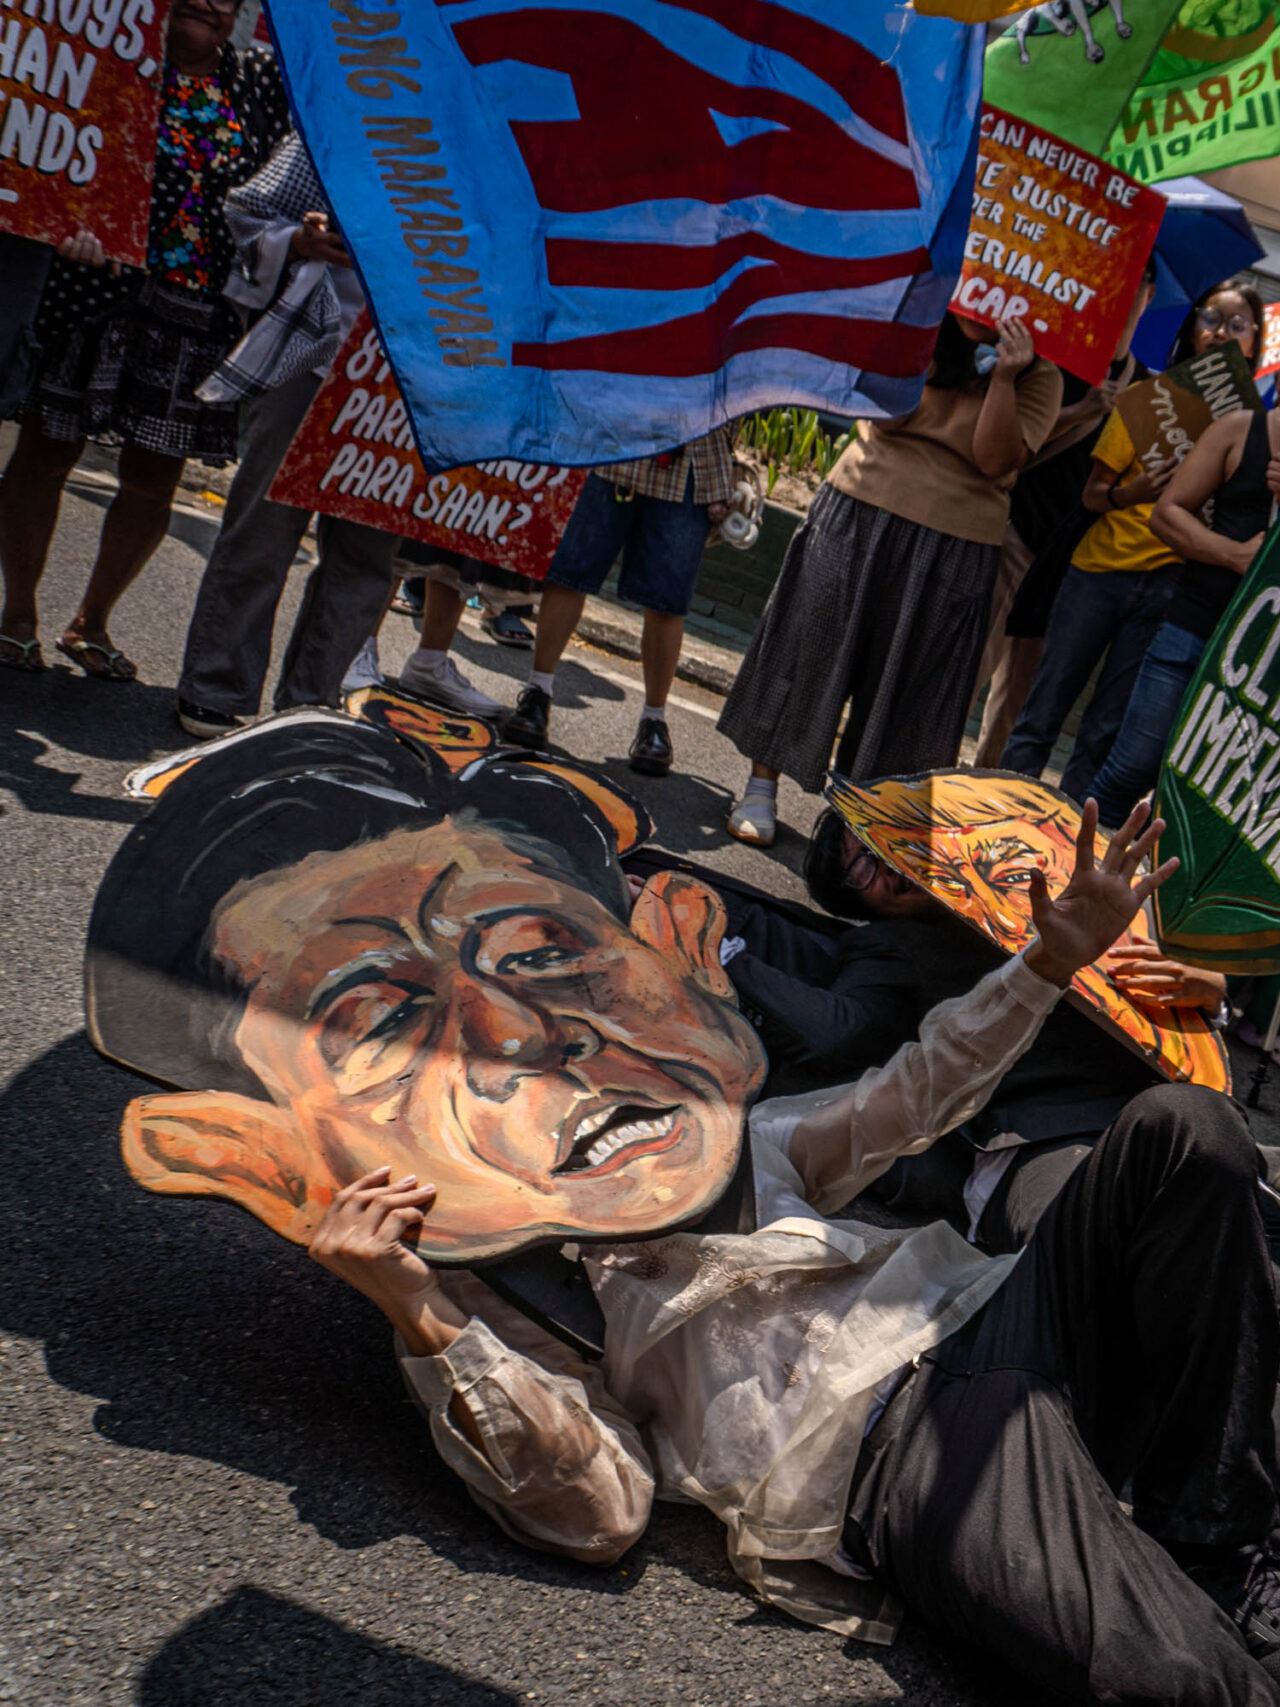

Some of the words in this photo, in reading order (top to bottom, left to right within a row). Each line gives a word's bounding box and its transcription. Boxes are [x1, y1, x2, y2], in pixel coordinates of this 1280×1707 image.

[328, 0, 424, 99] ANG
[0, 90, 103, 184] NDS
[979, 112, 1026, 149] CAN
[1026, 135, 1101, 189] NEVER
[1105, 174, 1140, 208] BE
[361, 115, 508, 368] MAKABAYAN
[1011, 175, 1121, 247] JUSTICE
[1013, 213, 1048, 243] THE
[963, 231, 1097, 312] ERIALIST
[318, 443, 415, 508] PARA
[411, 474, 534, 545] SAAN?
